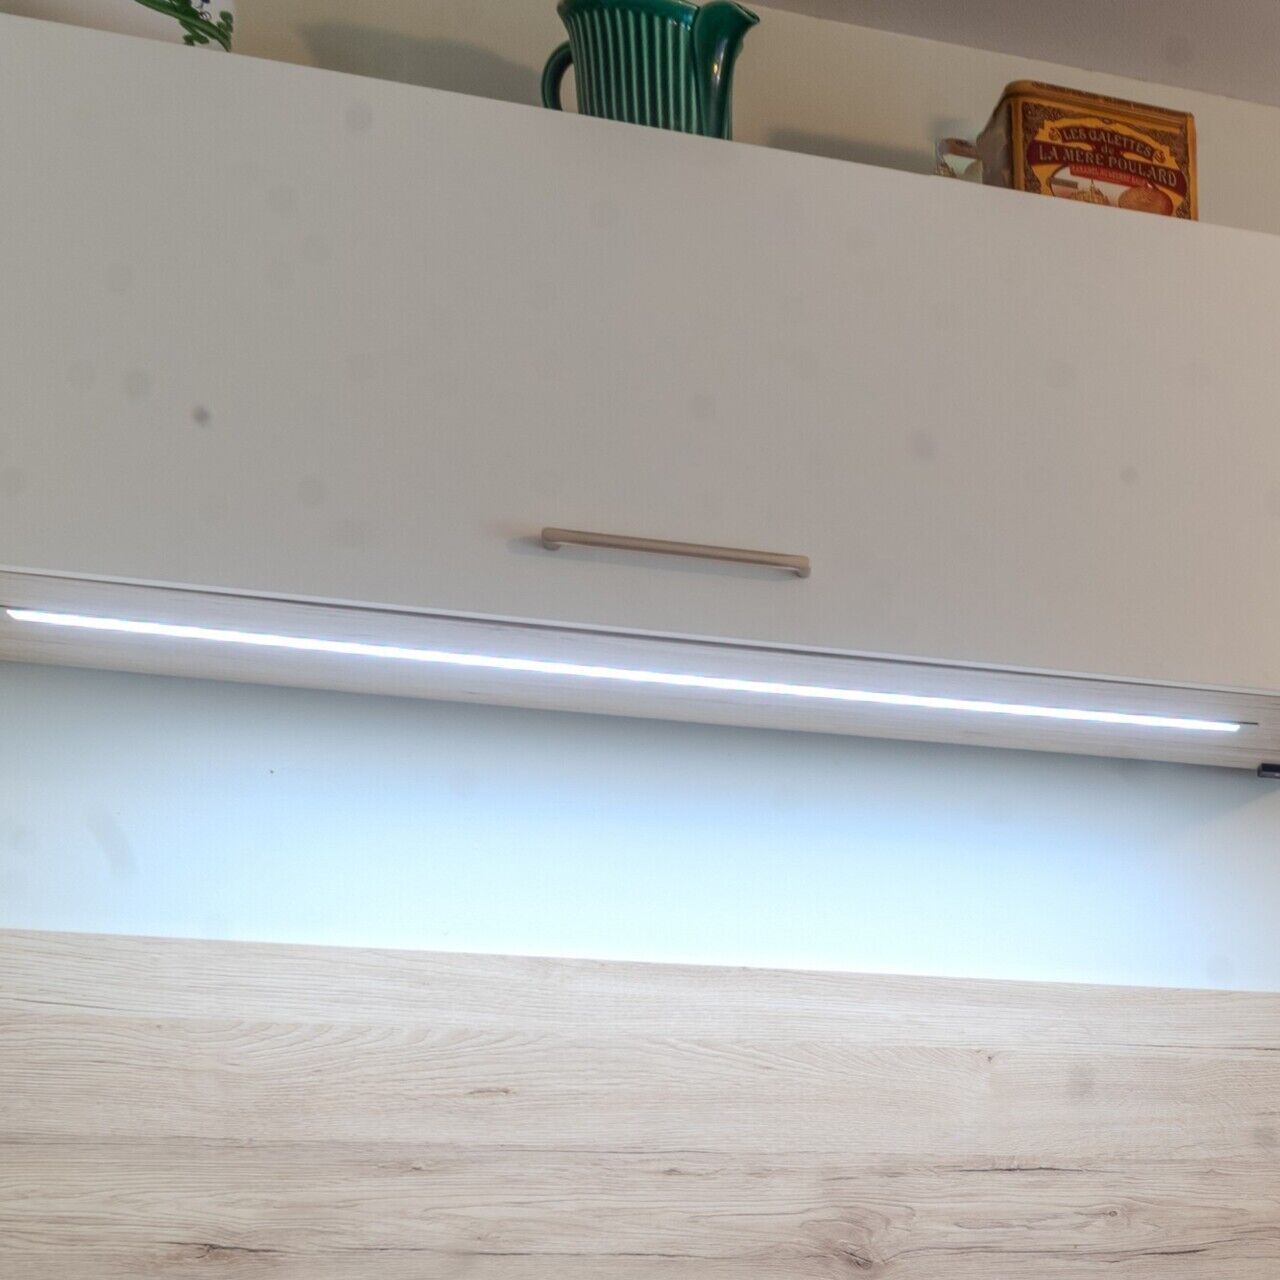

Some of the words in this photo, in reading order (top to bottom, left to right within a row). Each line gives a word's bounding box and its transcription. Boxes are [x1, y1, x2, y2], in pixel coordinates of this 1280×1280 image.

[1063, 128, 1087, 141] LES
[1088, 130, 1150, 156] GALETTES
[1038, 145, 1059, 160] LA
[1108, 155, 1177, 187] POULARD
